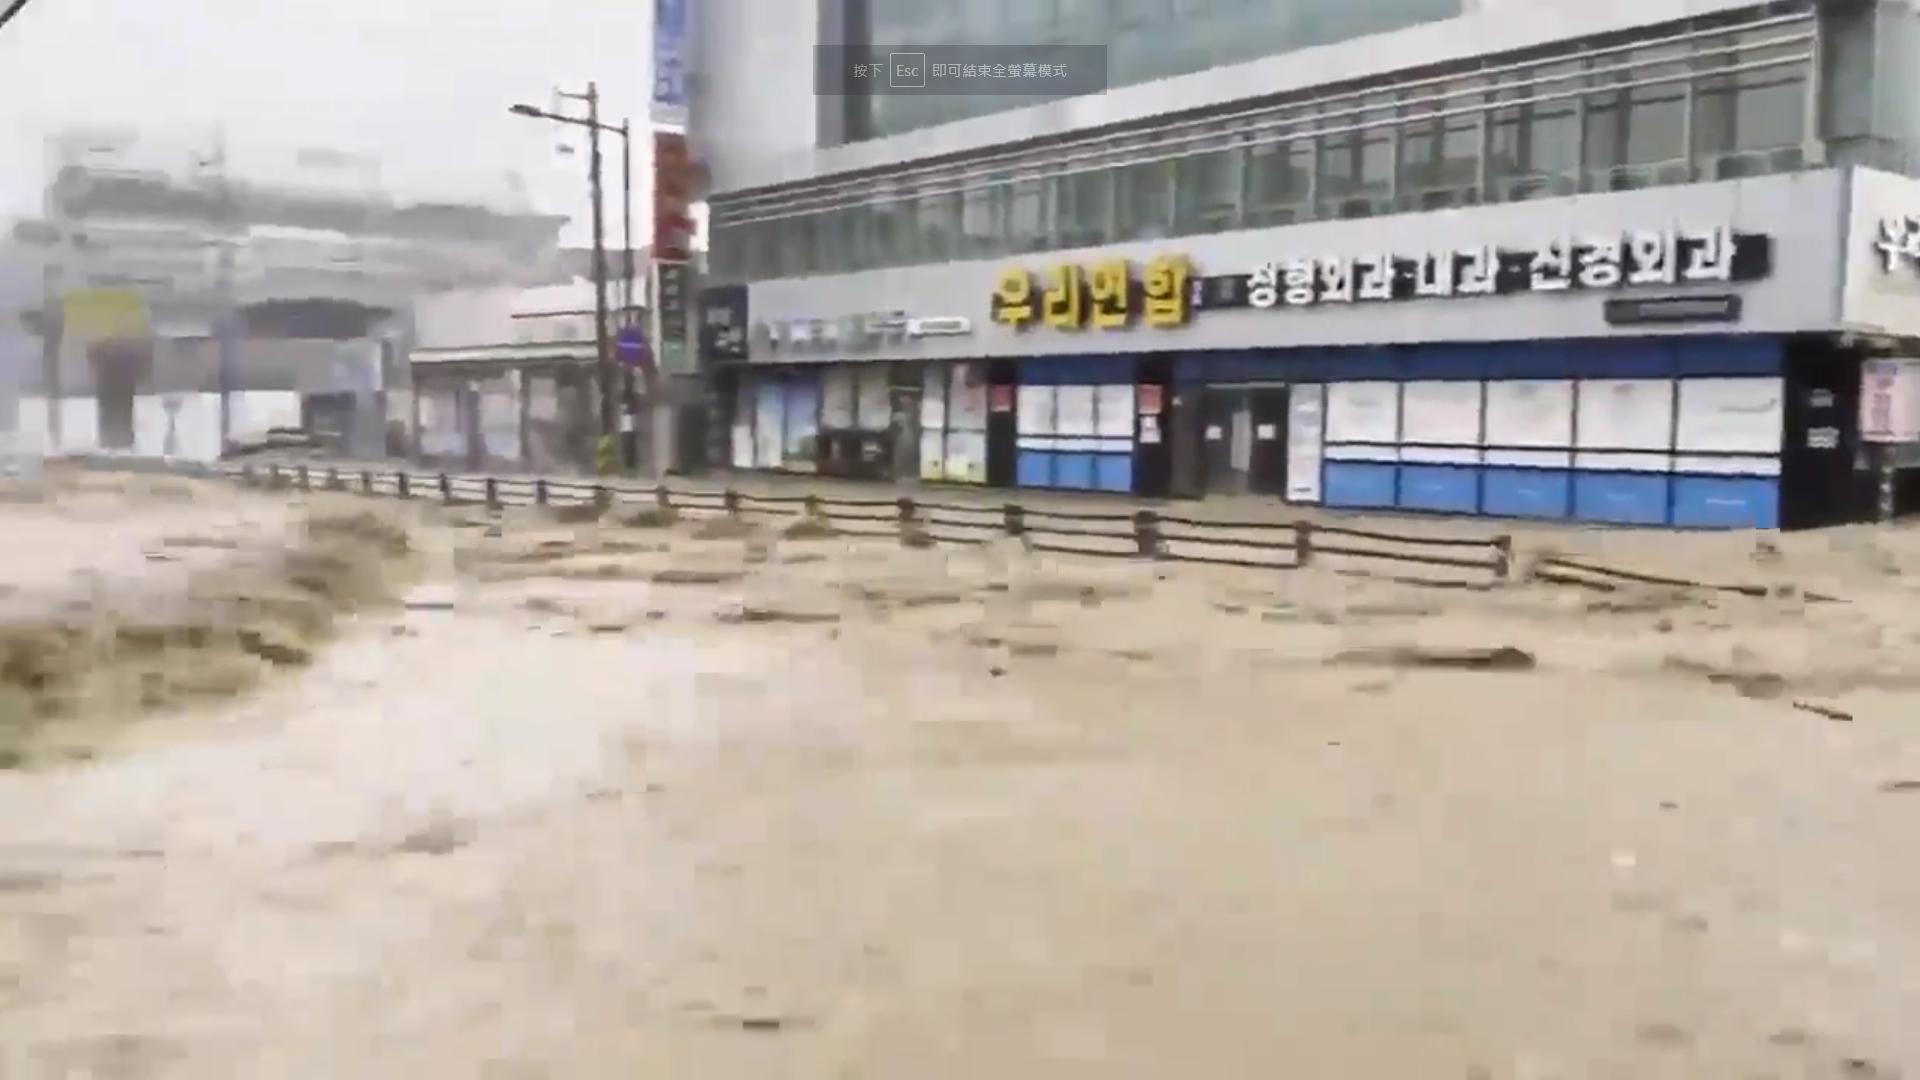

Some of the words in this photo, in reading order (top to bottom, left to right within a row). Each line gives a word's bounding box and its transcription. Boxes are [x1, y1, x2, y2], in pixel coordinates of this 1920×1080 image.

[996, 256, 1188, 328] 우리연합
[1247, 253, 1394, 308] 정형외과
[1529, 223, 1738, 291] 신경외과
